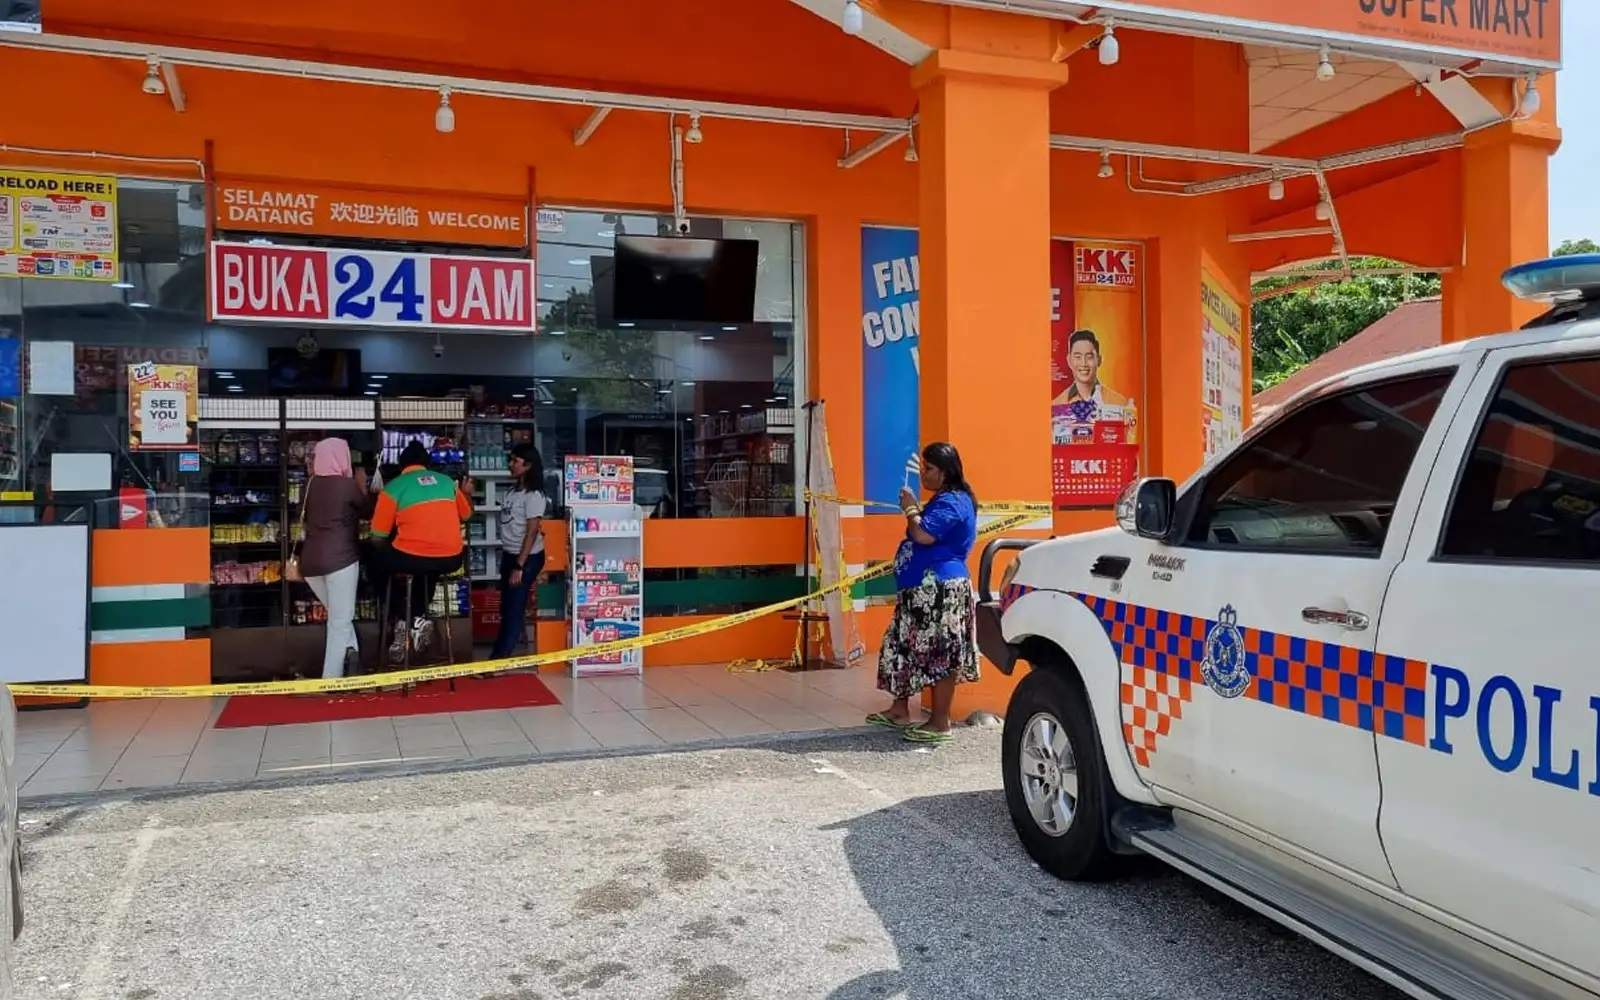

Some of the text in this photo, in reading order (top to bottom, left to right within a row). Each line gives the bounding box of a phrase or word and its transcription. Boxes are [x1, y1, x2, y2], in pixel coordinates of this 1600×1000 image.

[1469, 0, 1547, 39] MART
[0, 177, 58, 190] RELOAD
[63, 181, 105, 193] HERE
[223, 188, 319, 209] SELAMAT
[229, 206, 314, 226] DATANG
[330, 202, 419, 227] 欢迎光临
[427, 210, 521, 231] WELCOME
[1083, 248, 1128, 274] KK
[223, 253, 524, 321] BUKA 24 JAM
[1097, 273, 1114, 284] 24
[150, 399, 176, 409] SEE
[149, 410, 178, 420] YOU
